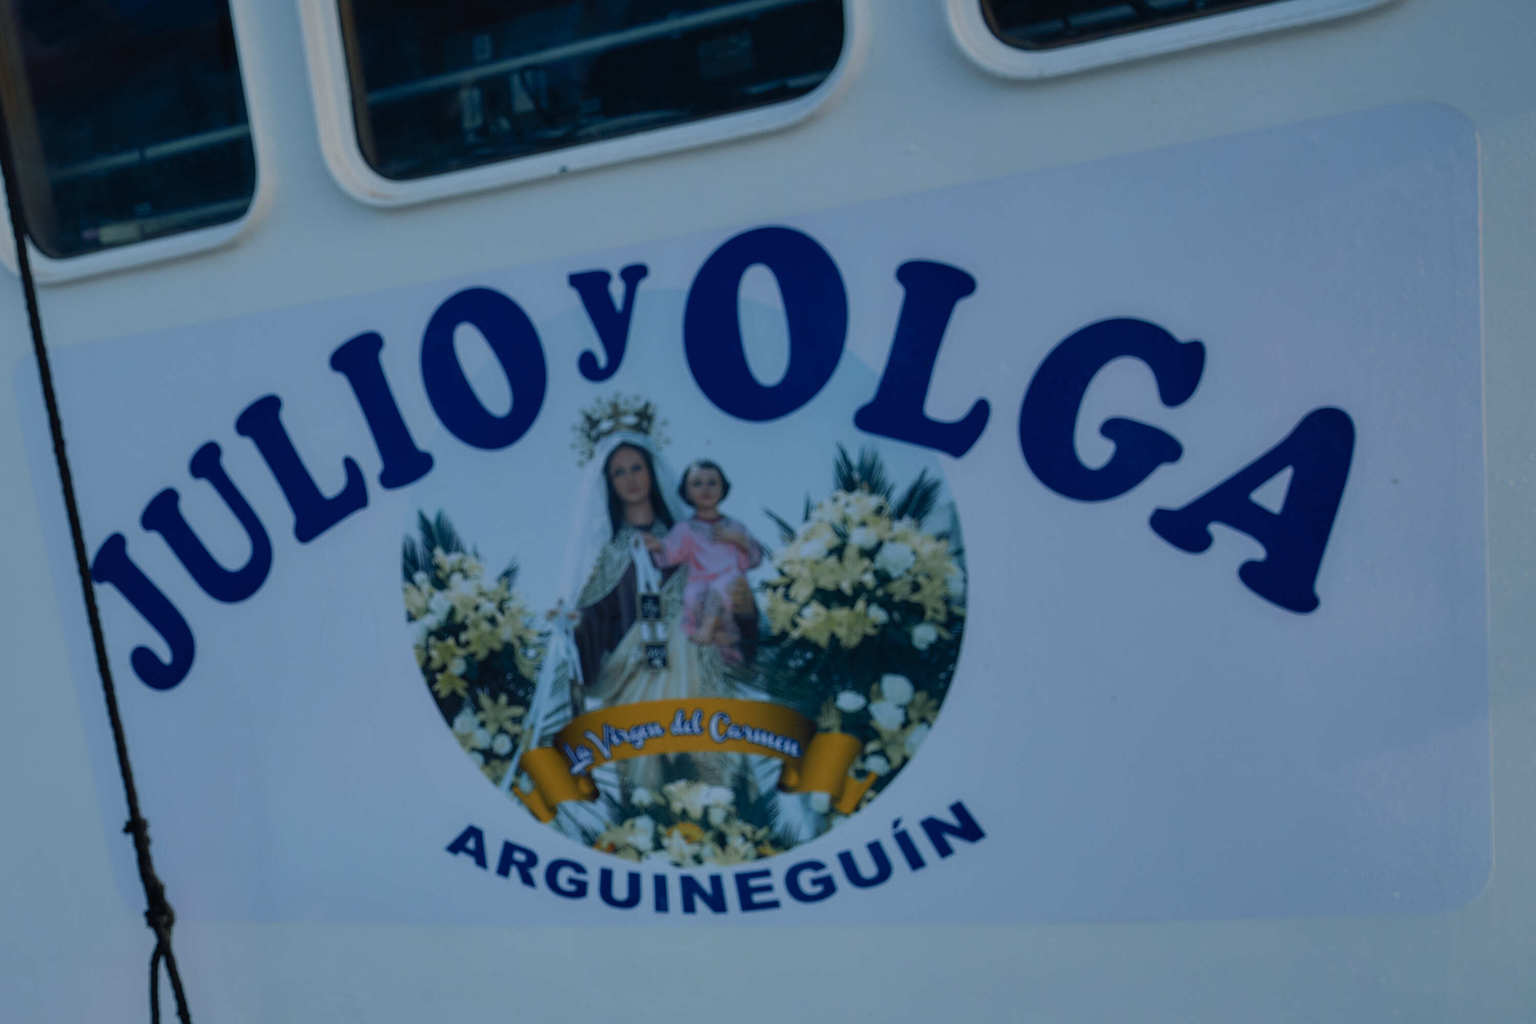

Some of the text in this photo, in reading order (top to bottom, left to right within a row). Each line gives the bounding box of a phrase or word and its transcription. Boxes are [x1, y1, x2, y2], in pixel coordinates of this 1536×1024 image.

[87, 225, 1357, 692] JULIO y OLGA
[584, 722, 665, 760] Virgen
[670, 708, 704, 736] del
[708, 711, 803, 758] Carmen
[445, 800, 987, 915] ARGUINEGUÍN
